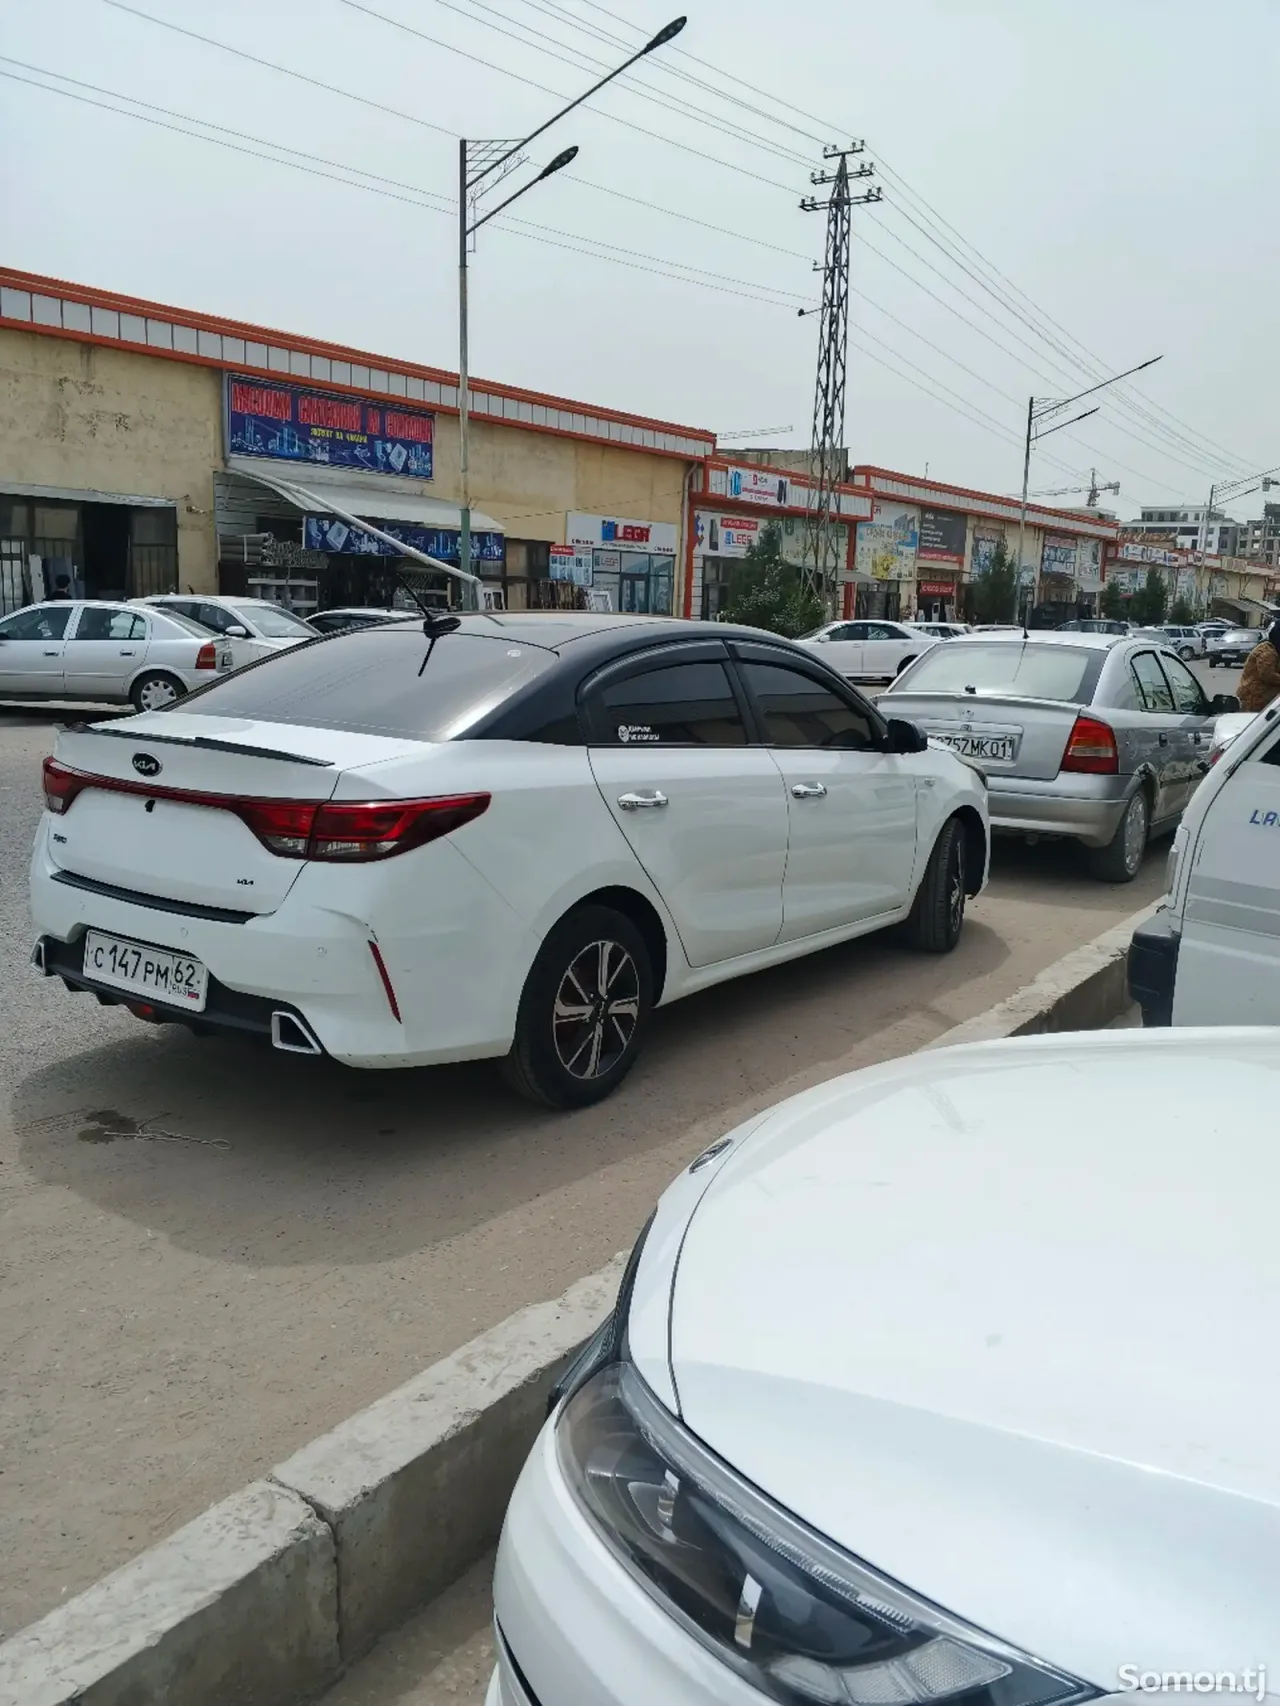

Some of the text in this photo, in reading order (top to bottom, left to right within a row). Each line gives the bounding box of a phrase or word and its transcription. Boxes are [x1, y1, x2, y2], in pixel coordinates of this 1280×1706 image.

[133, 760, 156, 770] KIA
[1249, 809, 1280, 827] LA
[174, 961, 196, 987] 62
